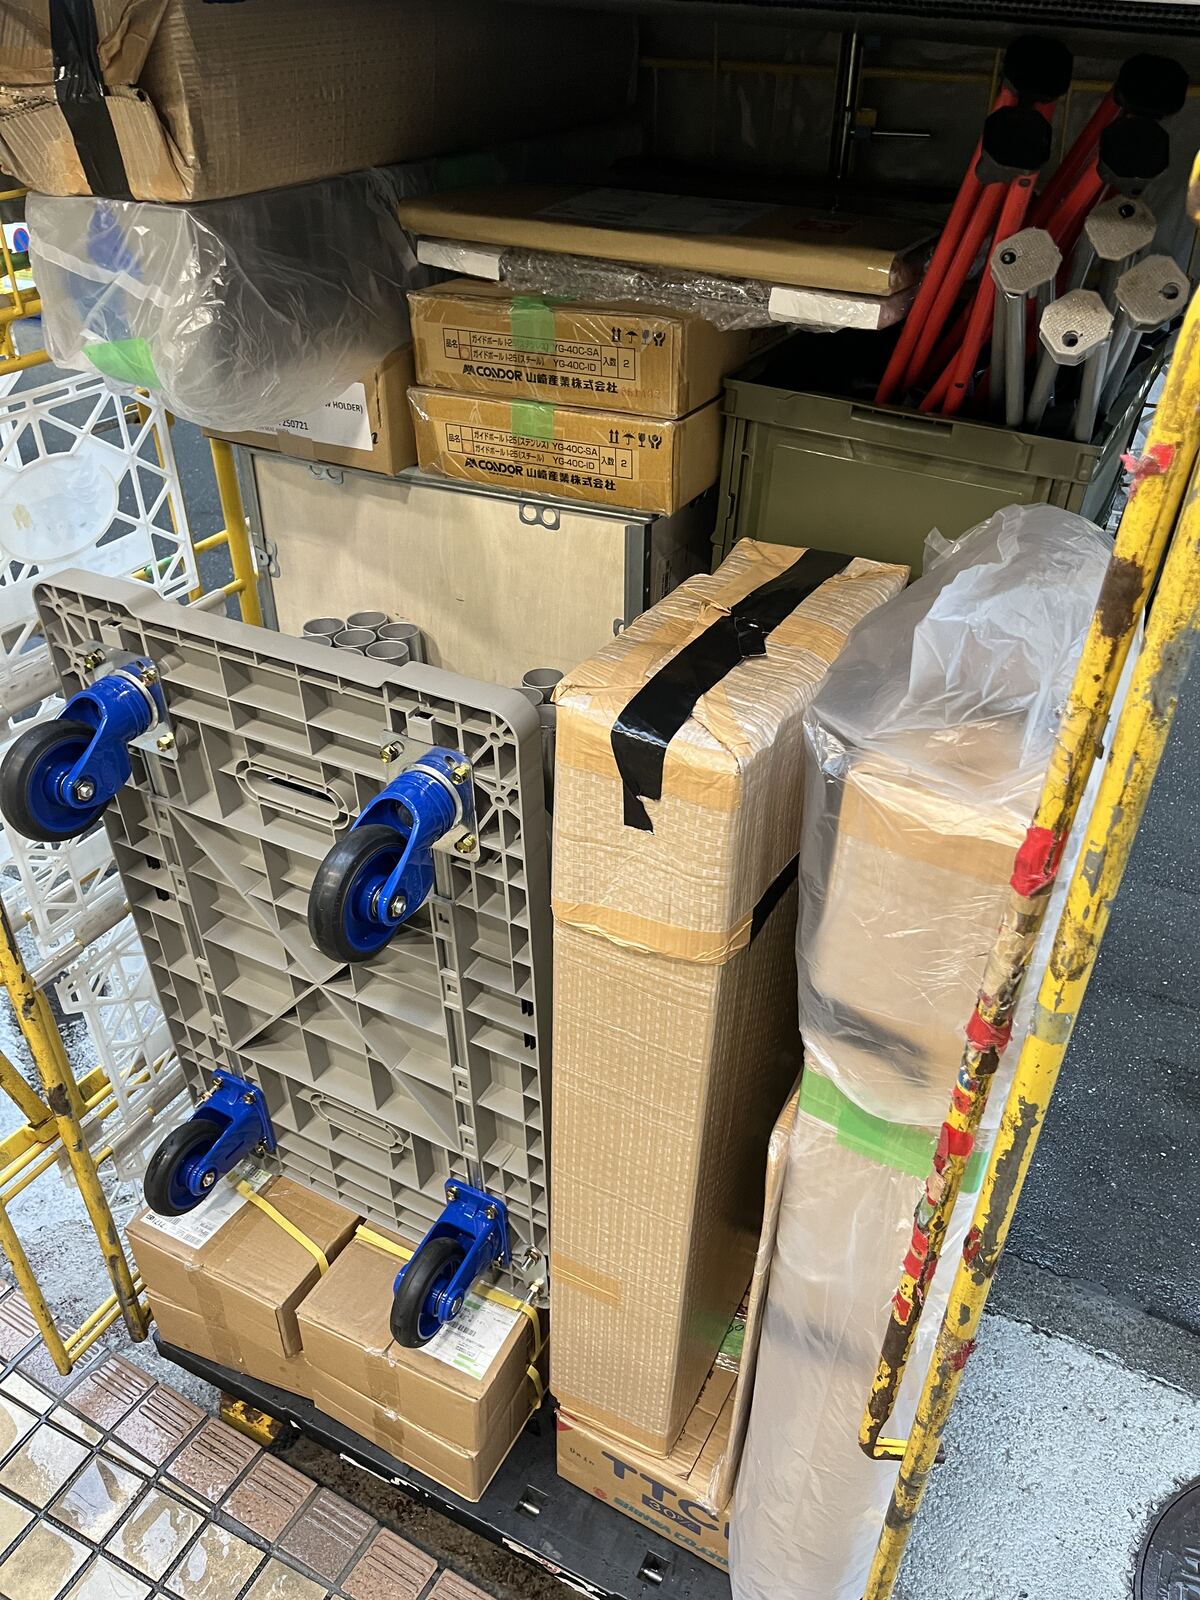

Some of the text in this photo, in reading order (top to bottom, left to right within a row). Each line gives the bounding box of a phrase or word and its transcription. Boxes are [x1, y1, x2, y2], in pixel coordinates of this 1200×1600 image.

[553, 359, 597, 372] YG-40C-ID
[603, 356, 630, 368] 入数 2
[476, 366, 523, 381] CONDOR
[526, 372, 619, 394] 山崎産業株式会社
[333, 401, 363, 414] HOLDER)
[552, 442, 598, 456] YG-40C-SA
[552, 456, 595, 470] YG-40C-ID
[601, 456, 628, 468] 入数 2
[478, 460, 617, 491] CONDOR 山崎産業株式会社
[601, 1450, 729, 1540] TTC
